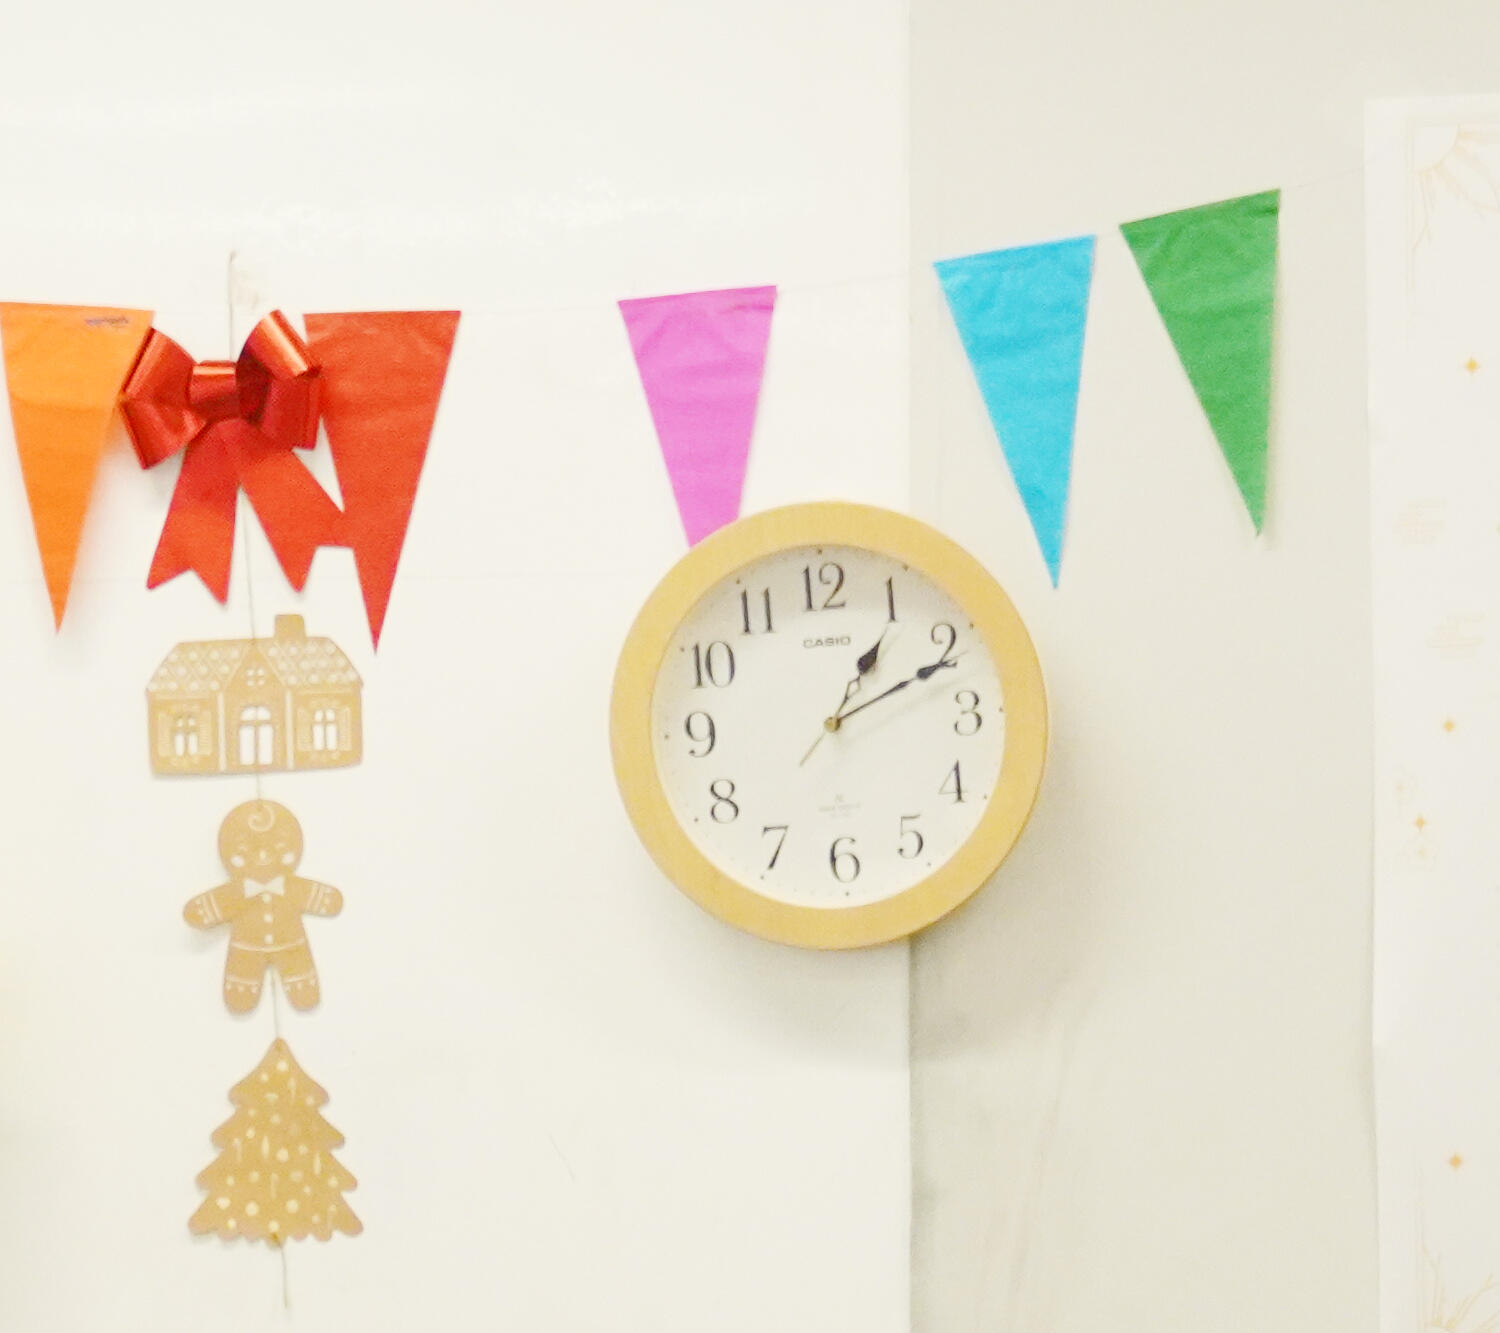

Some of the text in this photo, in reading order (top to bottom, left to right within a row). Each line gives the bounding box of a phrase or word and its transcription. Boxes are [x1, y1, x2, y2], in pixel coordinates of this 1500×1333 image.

[800, 562, 847, 612] 12
[885, 577, 899, 622] 1
[740, 587, 776, 635] 11
[691, 641, 735, 689] 10
[803, 636, 852, 649] CASIO
[930, 623, 958, 667] 2
[685, 711, 716, 758] 9
[953, 690, 983, 736] 3
[710, 779, 739, 824] 8
[938, 760, 968, 804] 4
[761, 825, 789, 870] 7
[898, 814, 924, 859] 5
[829, 837, 861, 883] 6
